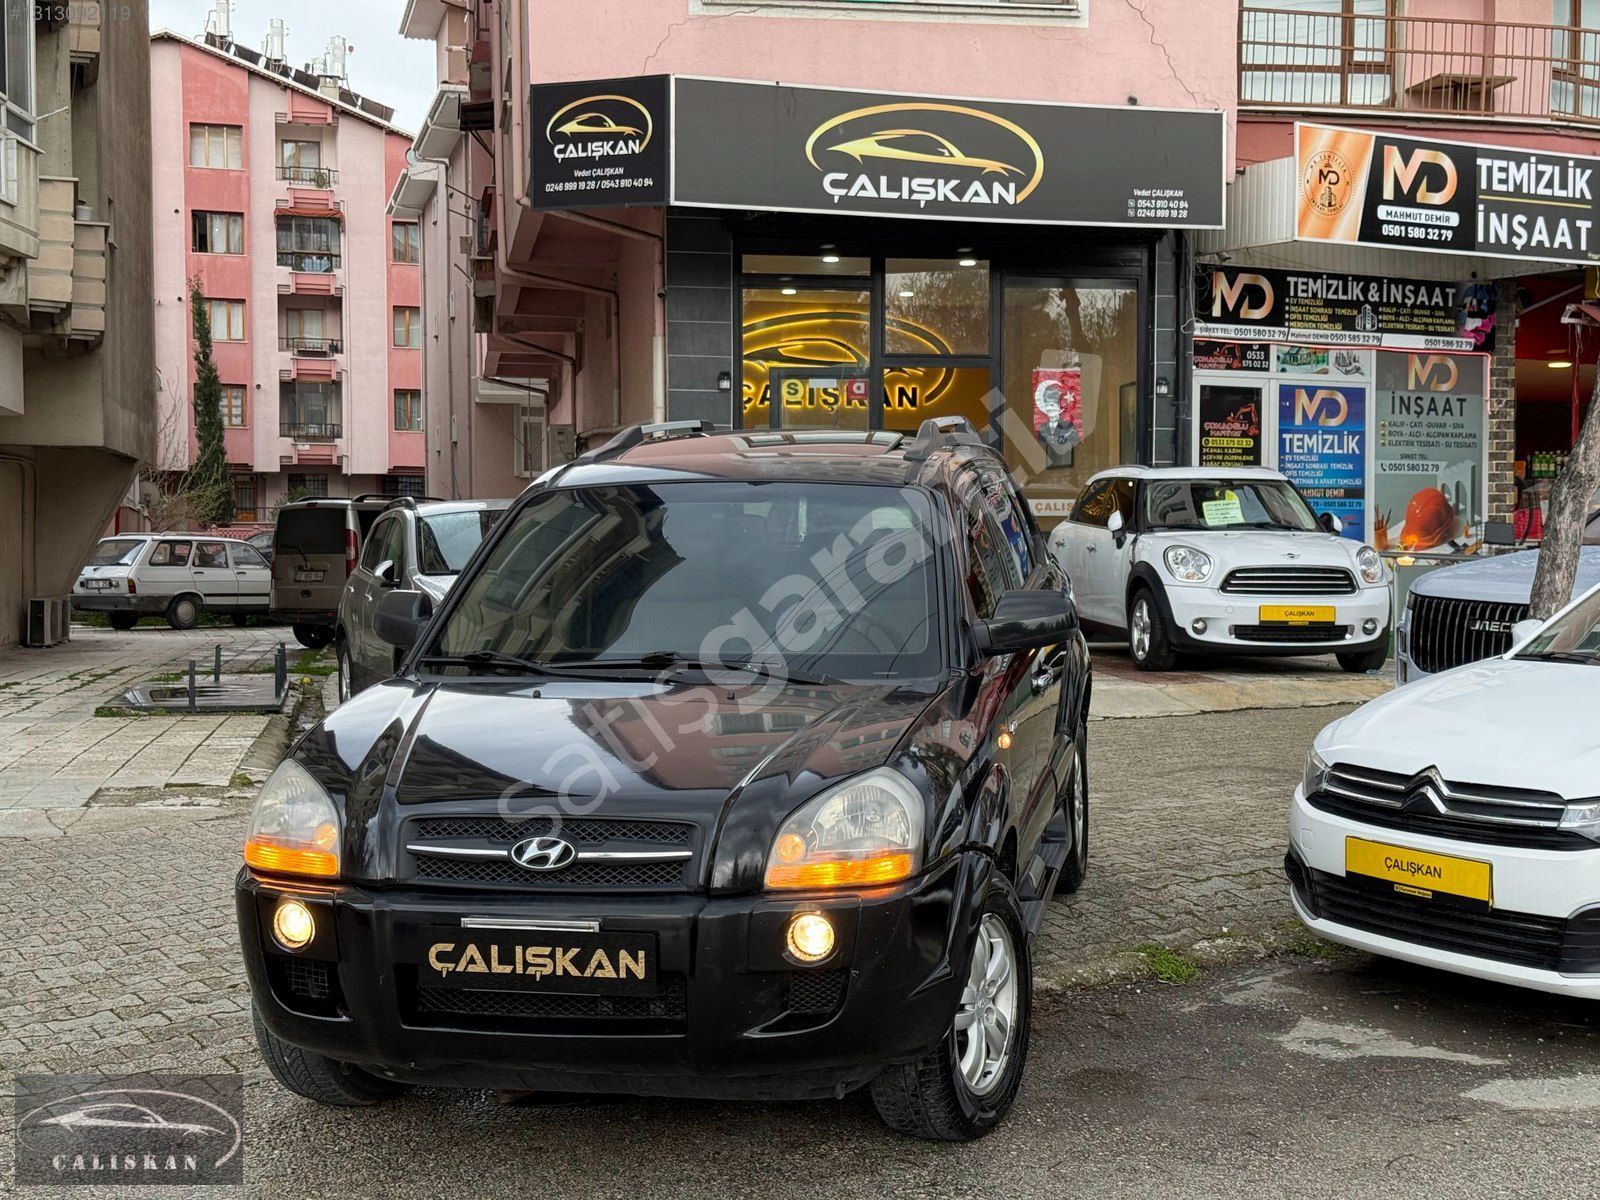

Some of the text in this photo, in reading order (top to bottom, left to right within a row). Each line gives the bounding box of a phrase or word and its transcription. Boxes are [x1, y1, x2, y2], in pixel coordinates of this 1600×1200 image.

[553, 139, 640, 163] ÇALIŞKAN
[574, 167, 624, 177] Vedat ÇALIŞKAN
[1383, 145, 1458, 205] MD
[1476, 156, 1593, 200] TEMİZLİK
[545, 183, 563, 192] 0246
[564, 182, 577, 191] 999
[578, 182, 586, 190] 19
[586, 181, 596, 189] 28
[601, 180, 619, 189] 0543
[620, 179, 632, 188] 910
[633, 178, 643, 187] 40
[643, 178, 654, 187] 94
[822, 172, 1016, 208] ÇALIŞKAN
[1152, 189, 1184, 198] ÇALIŞKAN
[1137, 199, 1189, 209] 0543 910 40 94
[1137, 209, 1156, 217] 0246
[1170, 210, 1178, 218] 19
[1178, 210, 1188, 218] 28
[1386, 210, 1451, 224] MAHMUT DEMİR
[1382, 224, 1453, 242] 0501 580 32 79
[1477, 204, 1592, 251] İNŞAAT
[1212, 271, 1274, 320] MD
[1286, 275, 1456, 308] TEMİZLİK & İNŞAAT
[1234, 328, 1251, 336] 0501
[1252, 328, 1267, 337] 580
[1268, 329, 1276, 338] 32
[1277, 330, 1286, 339] 79
[1330, 333, 1347, 341] 0501
[1348, 334, 1360, 342] 585
[1362, 335, 1370, 343] 32
[1371, 335, 1380, 343] 79
[1424, 338, 1473, 349] 0501 586 32 79
[1242, 360, 1269, 369] 575 02 32
[1246, 351, 1265, 360] 0533
[1295, 389, 1348, 426] MD
[1391, 391, 1467, 419] İNŞAAT
[1282, 430, 1360, 454] TEMİZLİK
[1388, 463, 1439, 472] 0501 580 32 79
[1384, 856, 1442, 878] ÇALIŞKAN
[428, 943, 646, 981] ÇALIŞKAN
